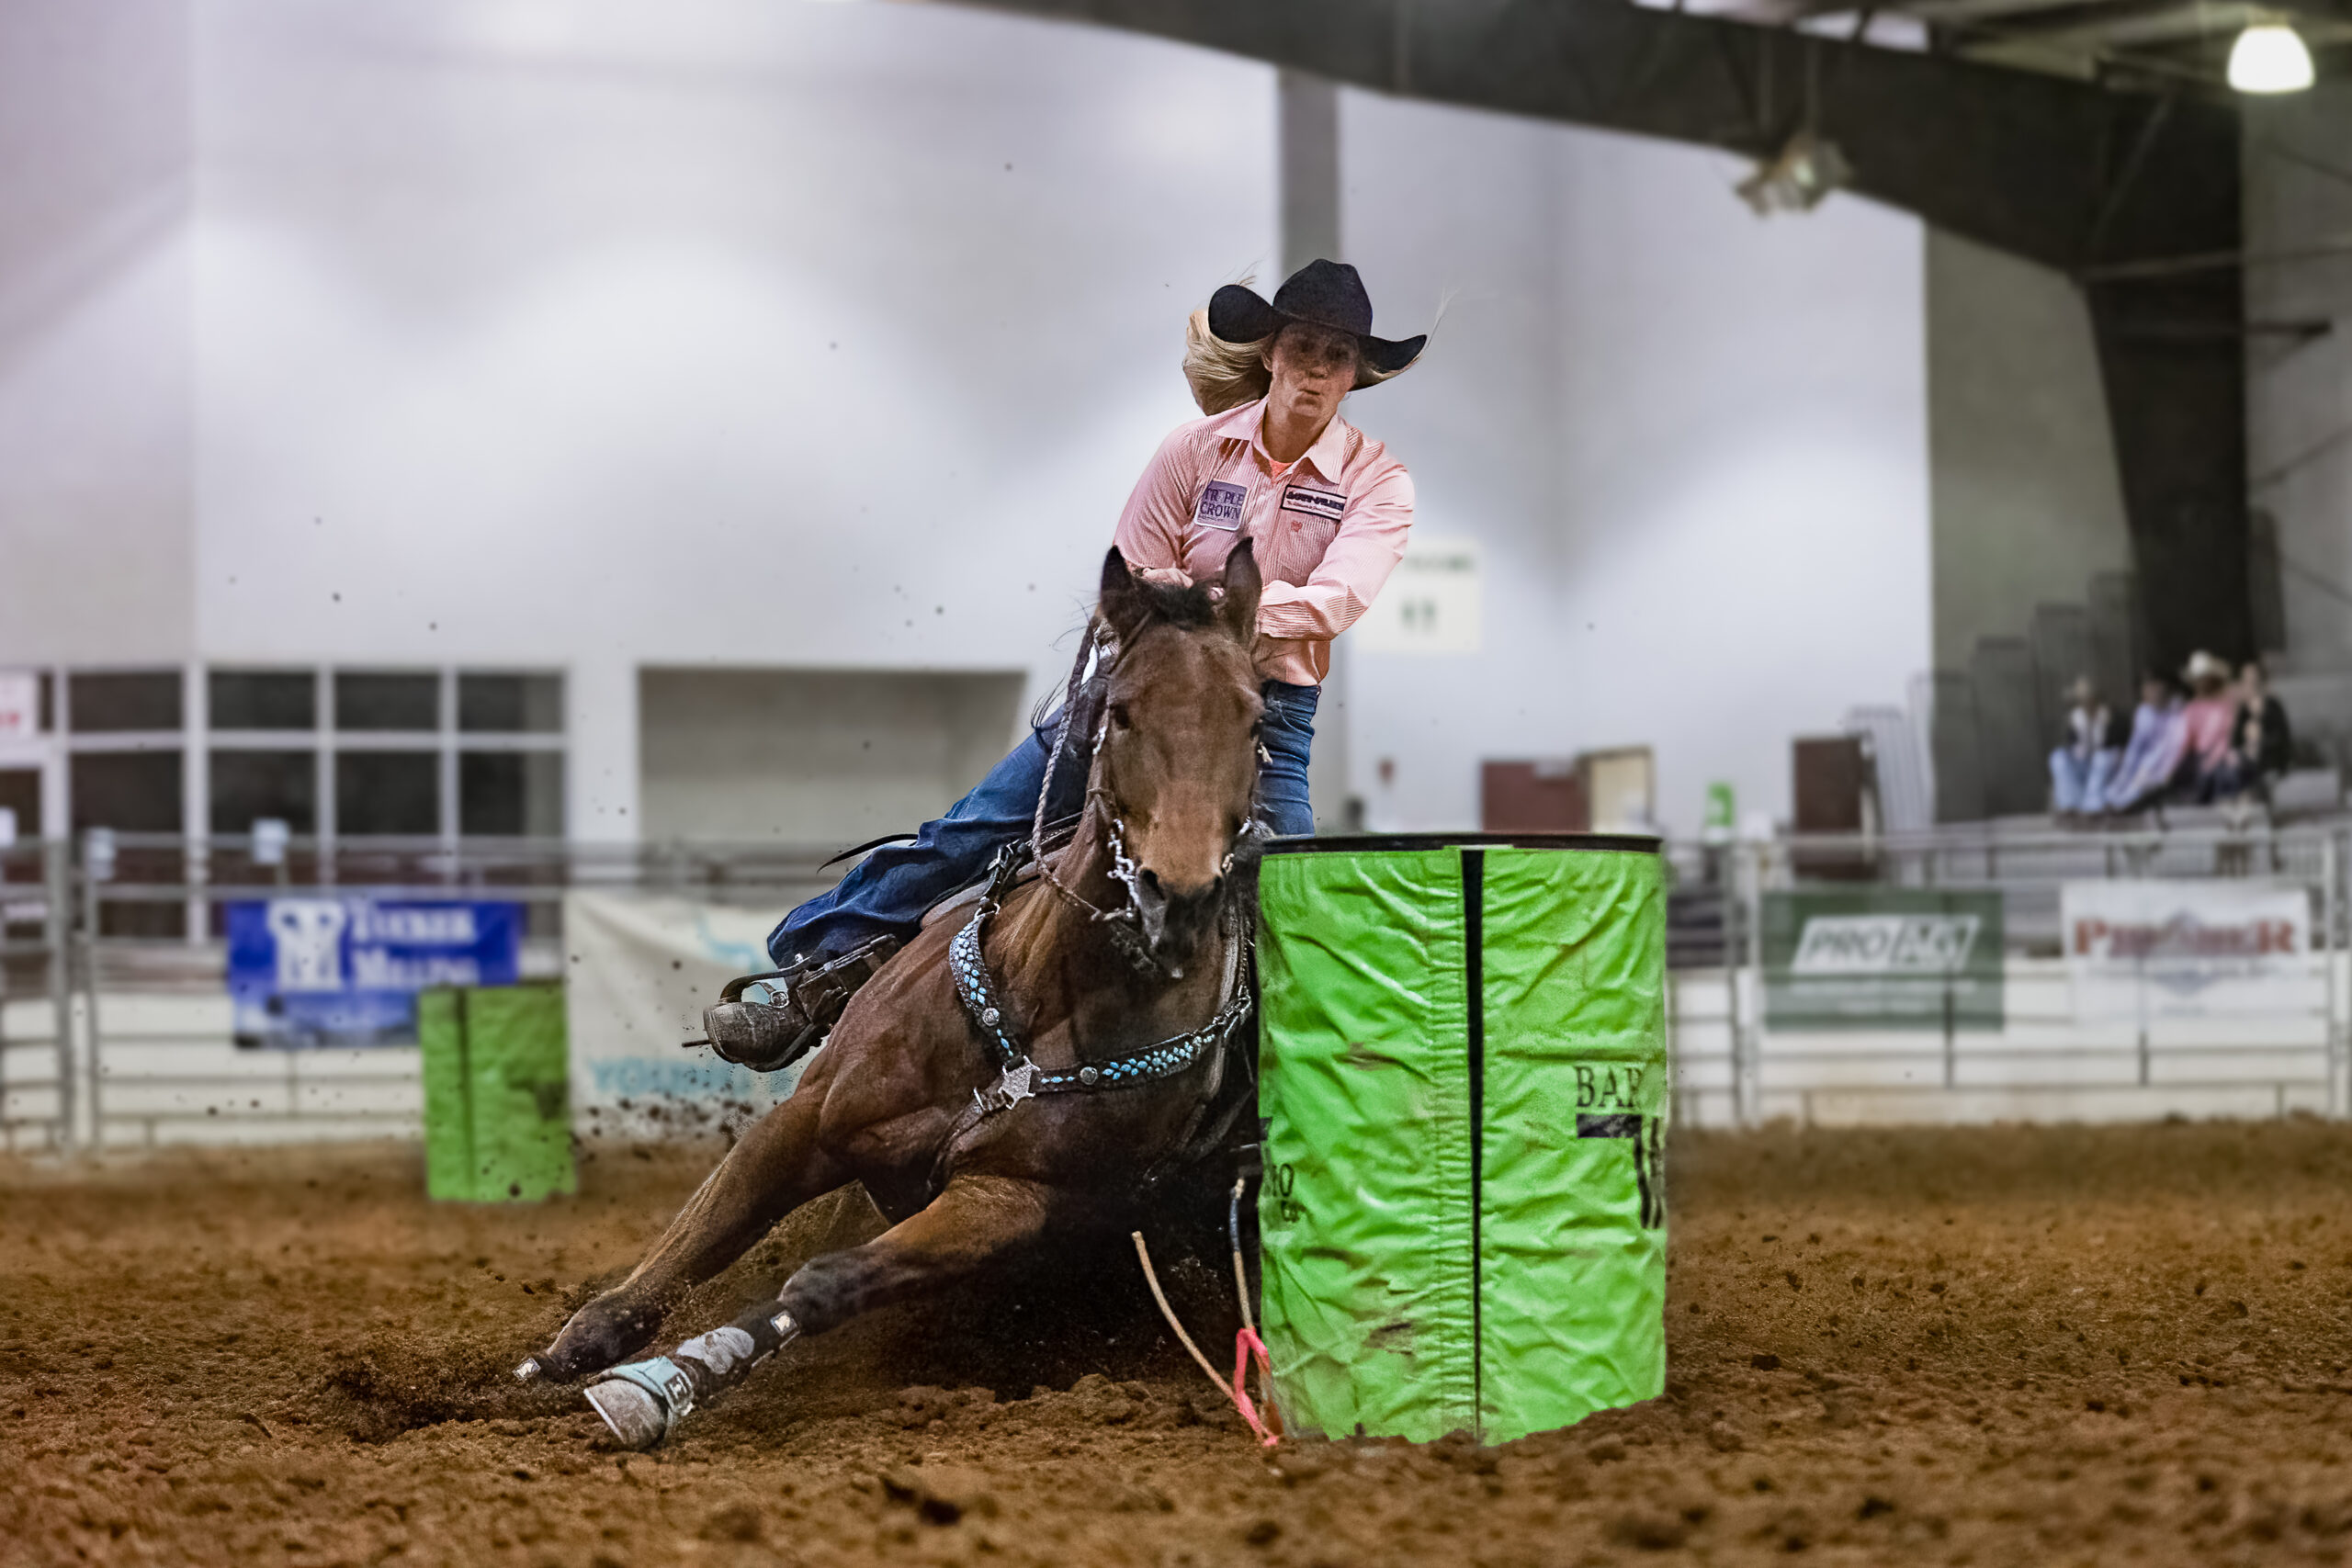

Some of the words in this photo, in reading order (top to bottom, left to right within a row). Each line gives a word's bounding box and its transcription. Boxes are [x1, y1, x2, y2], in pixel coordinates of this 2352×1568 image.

[1203, 488, 1245, 506] TRPLE
[1200, 502, 1241, 520] CROWN
[1805, 923, 1889, 960] PRO
